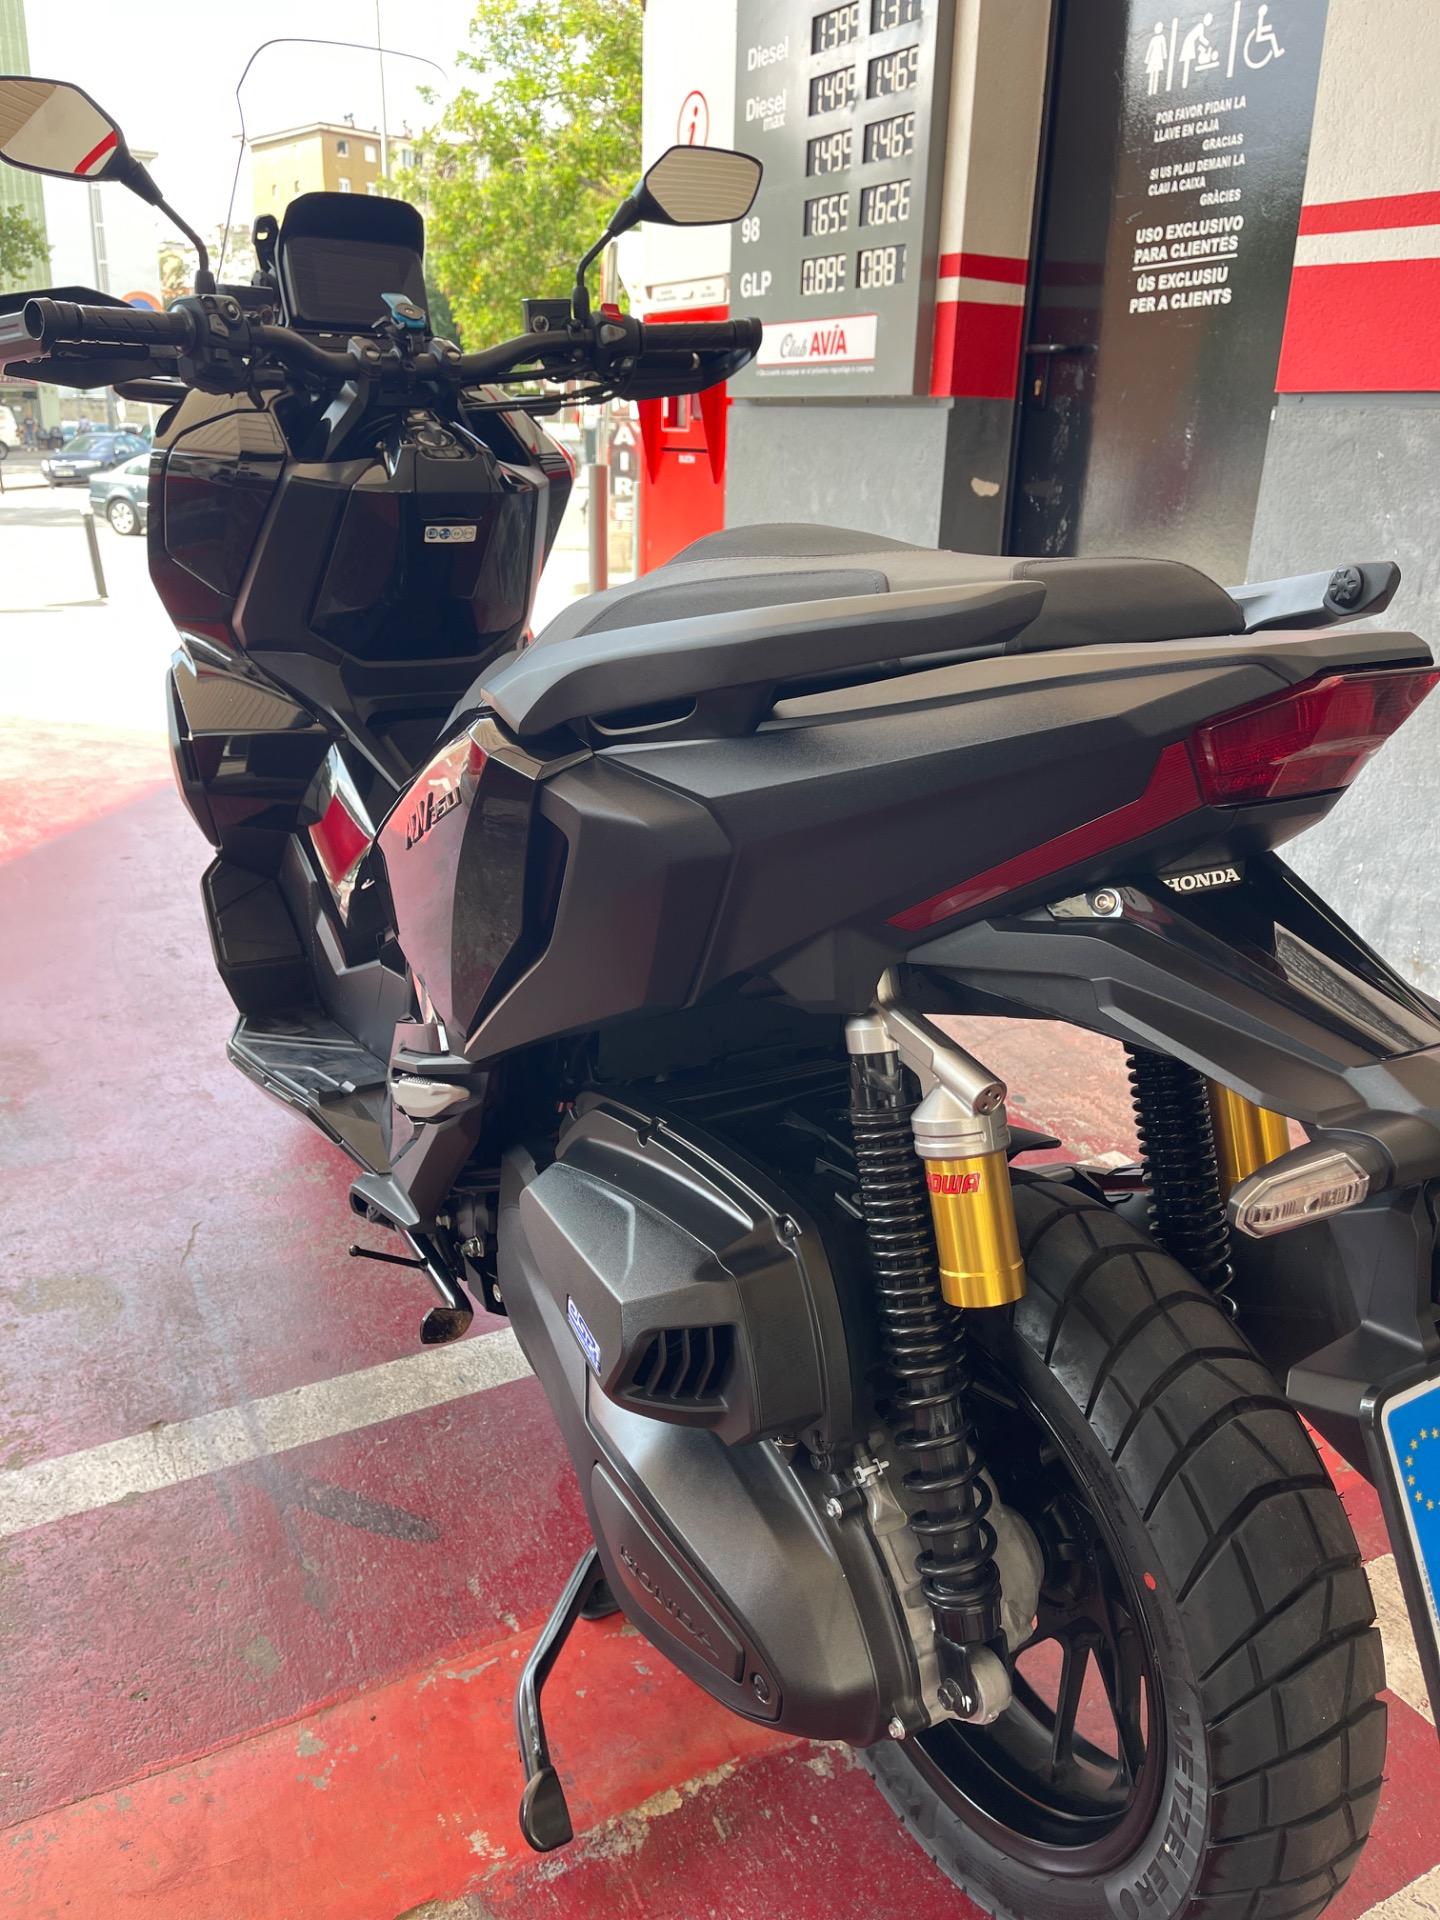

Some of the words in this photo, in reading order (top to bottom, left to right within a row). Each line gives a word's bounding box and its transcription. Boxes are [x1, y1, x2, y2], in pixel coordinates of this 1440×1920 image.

[747, 35, 789, 71] Diesel
[745, 88, 787, 122] Diesel
[1155, 110, 1174, 125] POR
[1174, 104, 1203, 121] FAVOR
[1204, 98, 1232, 115] PIDAN
[1233, 95, 1246, 109] LA
[762, 112, 786, 132] max
[1153, 126, 1181, 143] LLAVE
[1181, 123, 1194, 137] EN
[1196, 118, 1219, 134] CAJA
[1202, 133, 1244, 151] GRACIAS
[1149, 167, 1159, 180] SI
[1160, 165, 1172, 179] US
[1172, 161, 1195, 177] PLAU
[1196, 155, 1232, 172] DEMANI
[1233, 153, 1245, 167] LA
[1148, 180, 1170, 197] CLAU
[1170, 181, 1178, 193] A
[1179, 176, 1206, 191] CAIXA
[1199, 188, 1241, 206] GRÀCIES
[741, 216, 760, 243] 98
[1135, 226, 1164, 244] USO
[1165, 215, 1244, 240] EXCLUSIVO
[1134, 245, 1168, 264] PARA
[1170, 235, 1239, 259] CLIENTES
[740, 270, 772, 298] GLP
[1136, 273, 1156, 293] ÚS
[1157, 266, 1229, 290] EXCLUSIU
[1129, 296, 1156, 314] PER
[1157, 295, 1168, 311] A
[1170, 287, 1232, 309] CLIENTS
[779, 333, 808, 359] Club
[1163, 868, 1241, 892] HONDA
